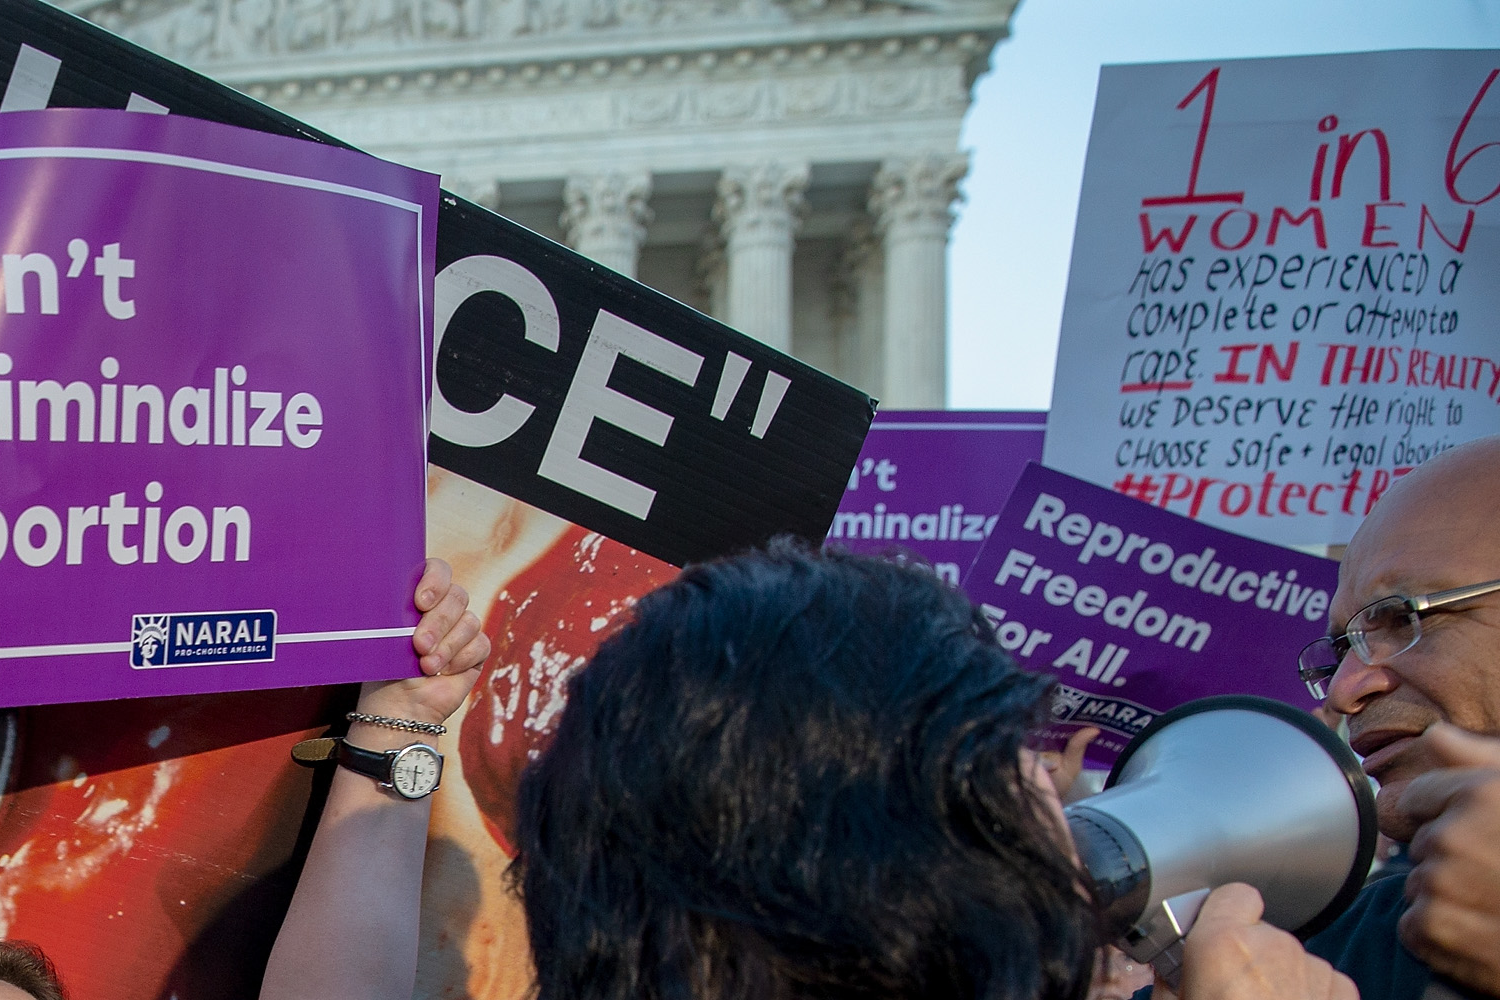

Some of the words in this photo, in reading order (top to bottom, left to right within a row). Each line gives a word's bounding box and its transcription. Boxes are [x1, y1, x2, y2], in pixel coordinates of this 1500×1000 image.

[1310, 114, 1391, 202] in
[1445, 68, 1500, 205] 6
[1140, 202, 1476, 253] WOMEN
[1440, 259, 1463, 294] a
[1292, 302, 1339, 331] or
[1213, 341, 1300, 384] IN
[1318, 343, 1403, 387] THIS
[1447, 397, 1463, 426] to
[1116, 437, 1210, 468] CHOOSE
[1322, 436, 1387, 480] legal
[1113, 471, 1415, 519] #ProtectR
[1023, 492, 1329, 622] Reproductive
[994, 548, 1212, 652] Freedom
[174, 647, 228, 657] PRO-CHOICE
[230, 645, 267, 653] AMERICA
[175, 619, 267, 646] NARAL
[1053, 637, 1130, 687] All.
[1081, 700, 1153, 729] NARA
